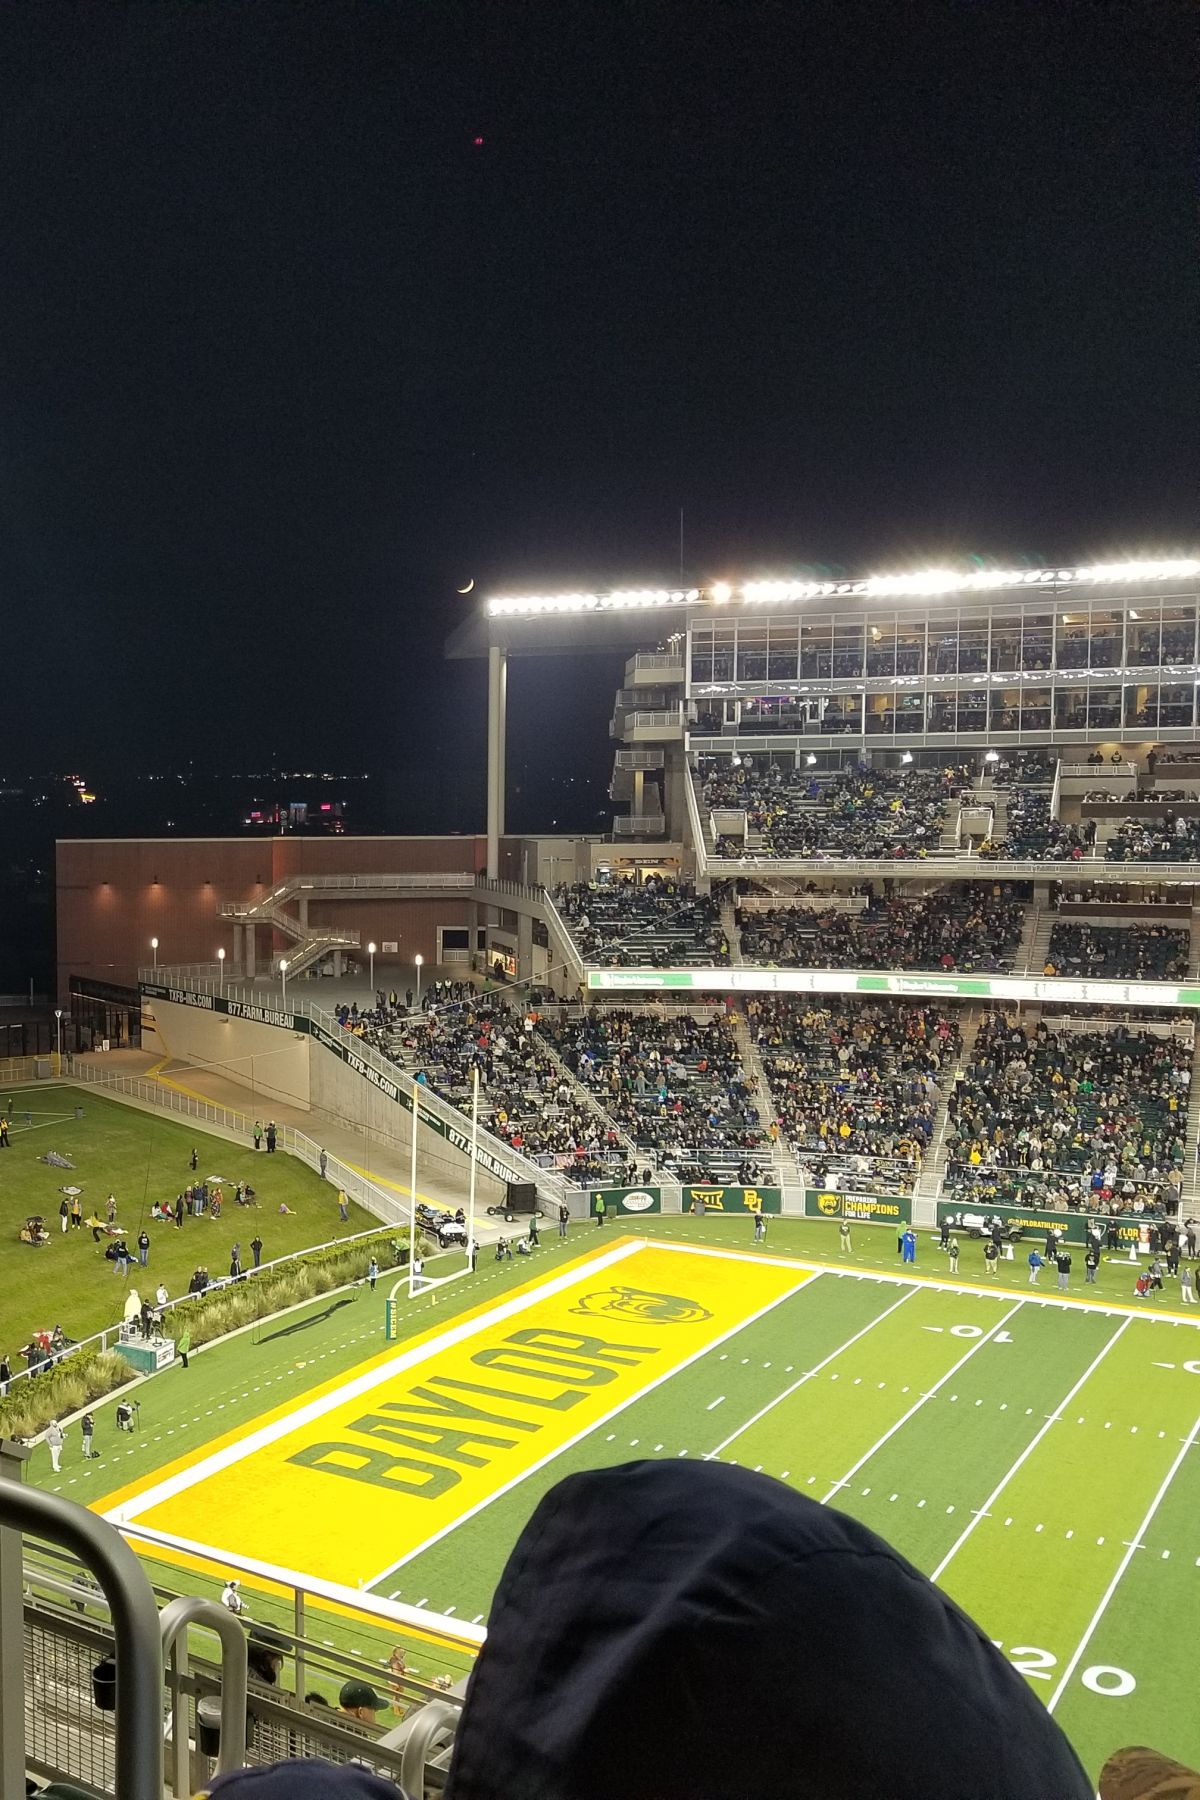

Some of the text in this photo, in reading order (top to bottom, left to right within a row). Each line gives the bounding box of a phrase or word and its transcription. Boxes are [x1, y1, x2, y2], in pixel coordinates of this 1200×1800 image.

[168, 988, 212, 1010] TXFB-INS.COM
[227, 1001, 295, 1029] 877.FARM.BUREAU
[346, 1052, 398, 1099] TXFB-INS.COM
[743, 1189, 763, 1213] BU
[844, 1201, 900, 1216] CHAMPIONS
[844, 1210, 871, 1219] FOR LIFE
[283, 1327, 662, 1500] BAYLOR
[1009, 1646, 1137, 1697] 20
